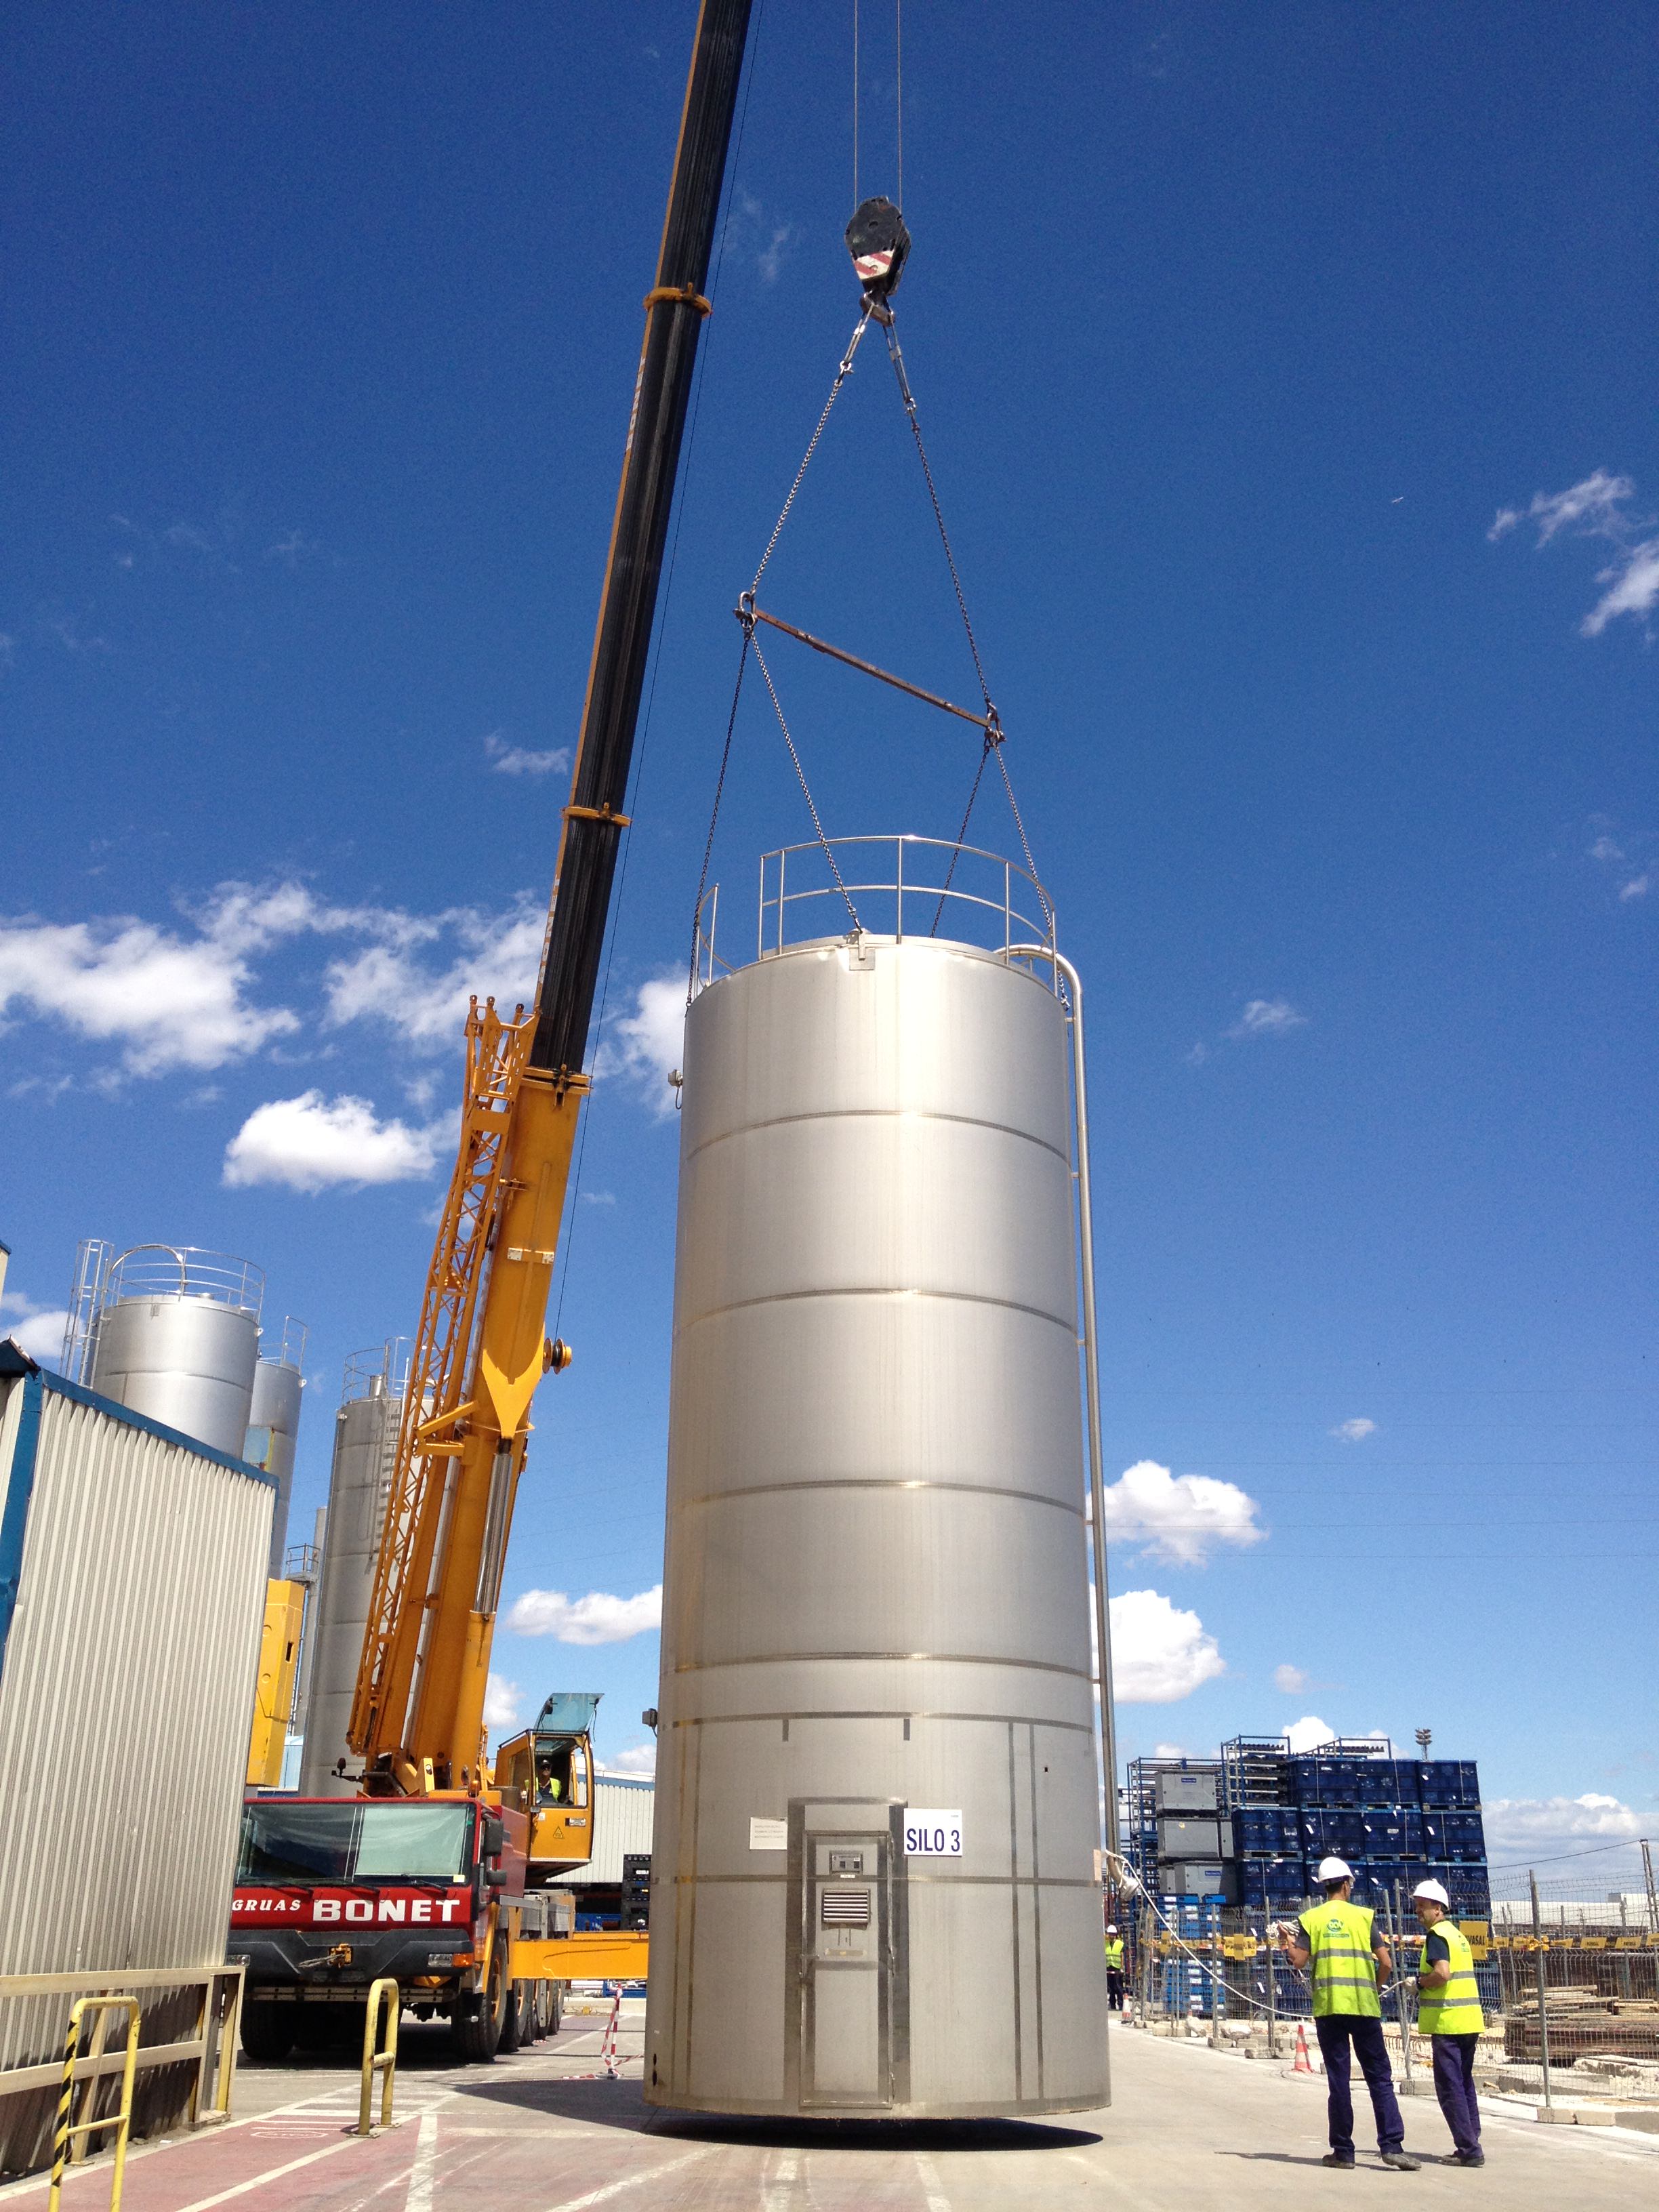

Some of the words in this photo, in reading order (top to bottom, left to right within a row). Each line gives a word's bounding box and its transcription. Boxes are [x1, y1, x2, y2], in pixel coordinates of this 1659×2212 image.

[907, 1828, 944, 1851] SILO
[951, 1830, 960, 1851] 3
[232, 1900, 301, 1911] GRUAS
[312, 1900, 460, 1921] BONET
